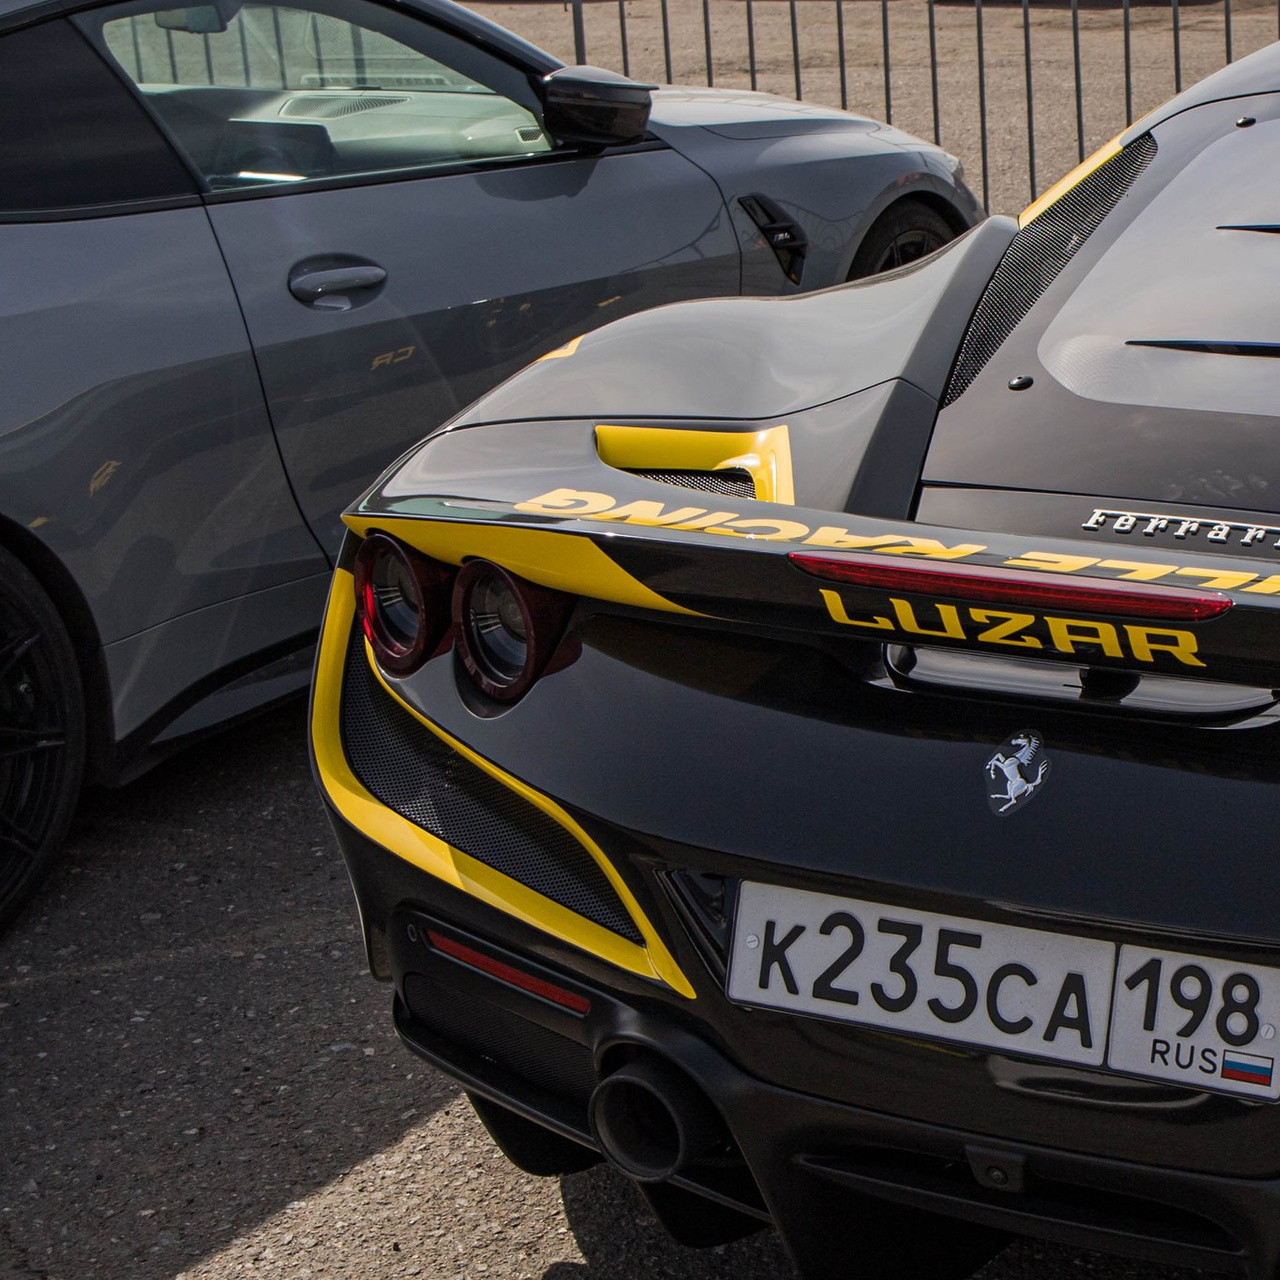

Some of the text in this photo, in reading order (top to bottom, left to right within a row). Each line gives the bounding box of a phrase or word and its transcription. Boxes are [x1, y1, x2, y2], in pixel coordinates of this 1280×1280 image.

[513, 487, 988, 561] RACING
[818, 587, 1207, 668] LUZAR
[1124, 957, 1261, 1047] 198
[1150, 1038, 1218, 1075] RUS
